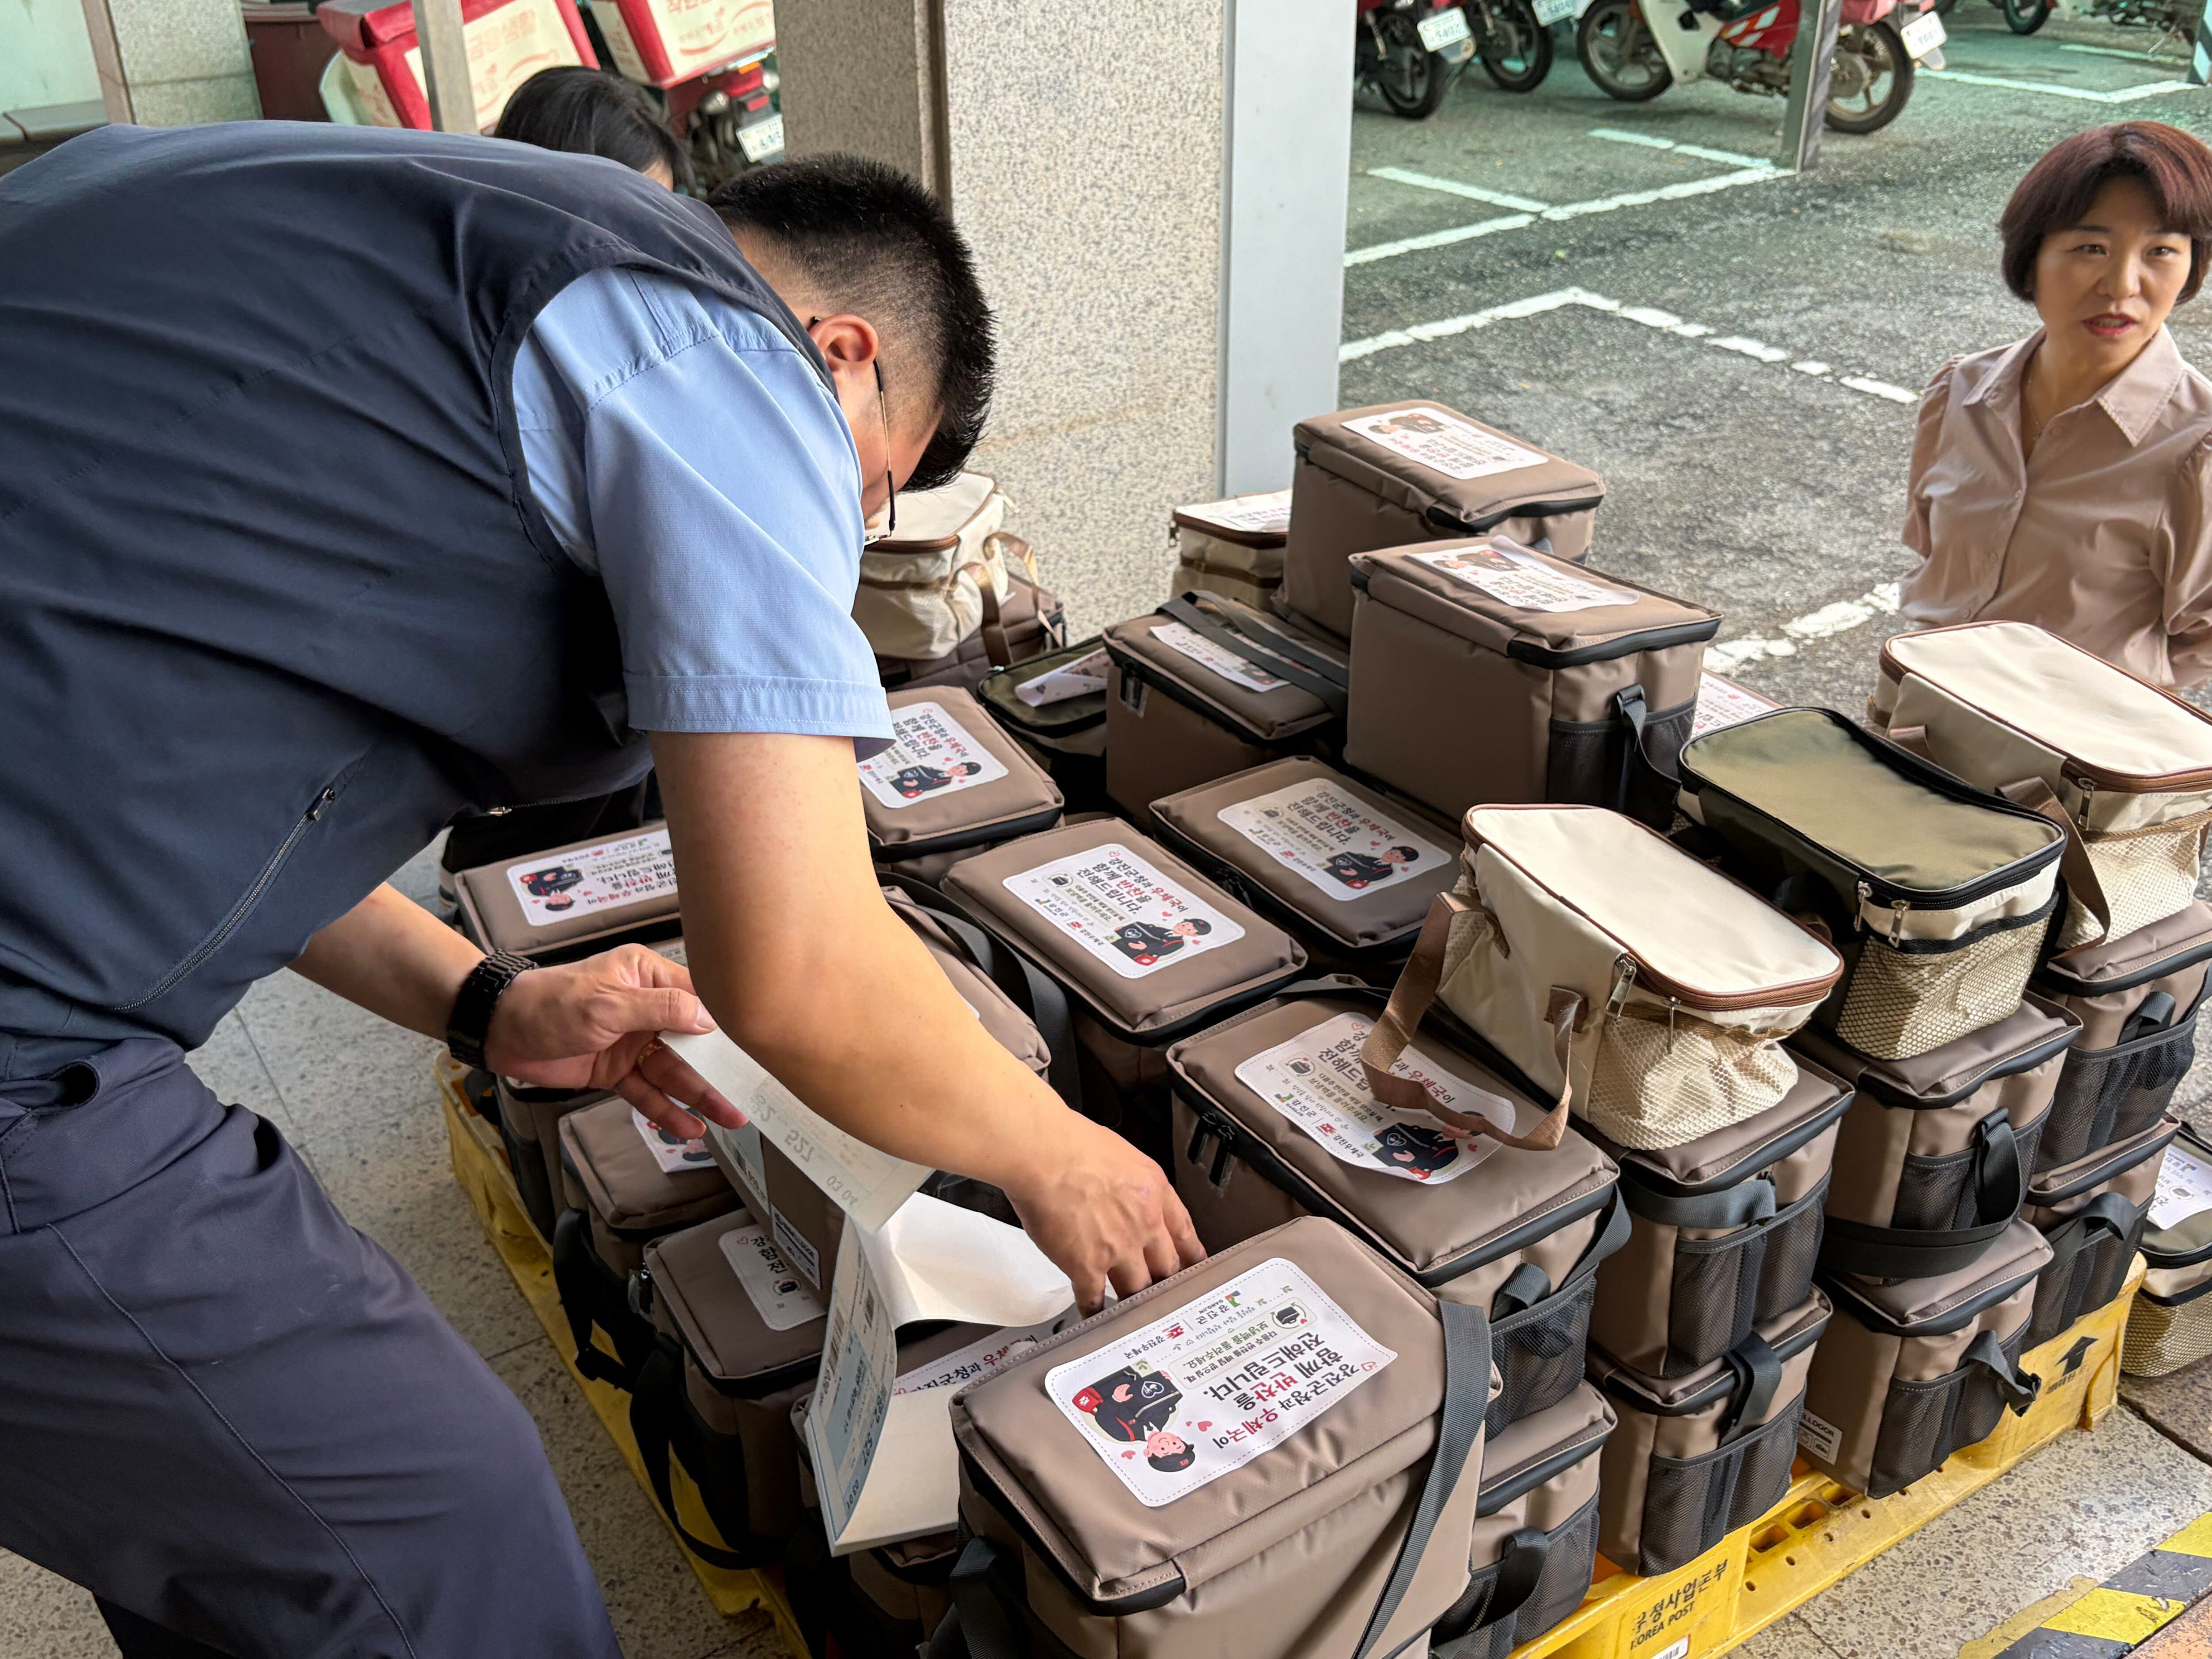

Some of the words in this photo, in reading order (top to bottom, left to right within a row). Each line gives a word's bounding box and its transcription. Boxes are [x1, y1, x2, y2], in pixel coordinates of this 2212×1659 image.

[917, 731, 942, 750] 반찬을
[1287, 802, 1351, 845] 전해드립니다.
[1301, 796, 1331, 813] 함께
[1325, 811, 1360, 833] 반찬을
[1317, 792, 1361, 819] 강진군청과
[1358, 818, 1395, 840] 우체국이
[1076, 868, 1142, 914] 전해드립니다.
[1092, 862, 1122, 880] 함께
[1116, 879, 1152, 903] 반찬을
[1109, 857, 1153, 888] 강진군청과
[1151, 887, 1188, 912] 우체국이
[1409, 1070, 1455, 1103] 우체국이
[1291, 1098, 1317, 1117] 강진군
[1196, 1305, 1230, 1324] 강진군
[1198, 1299, 1223, 1314] GANGJIN
[1235, 1306, 1255, 1318] 정성을
[1196, 1324, 1222, 1339] 전합니다
[1231, 1321, 1268, 1344] 보냉백을
[1255, 1330, 1277, 1345] 다음주
[1124, 1335, 1165, 1359] 강진우체국
[1183, 1340, 1232, 1368] 돌려주세요.
[1232, 1342, 1256, 1357] 반찬을
[1194, 1363, 1218, 1378] 받으실
[1203, 1332, 1324, 1401] 전해드립니다.
[1217, 1355, 1234, 1366] 배달
[1293, 1347, 1343, 1378] 함께
[1233, 1372, 1298, 1410] 반찬을
[1278, 1363, 1359, 1410] 강진군청과
[1212, 1408, 1278, 1449] 우체국이
[1668, 1601, 1695, 1625] POST
